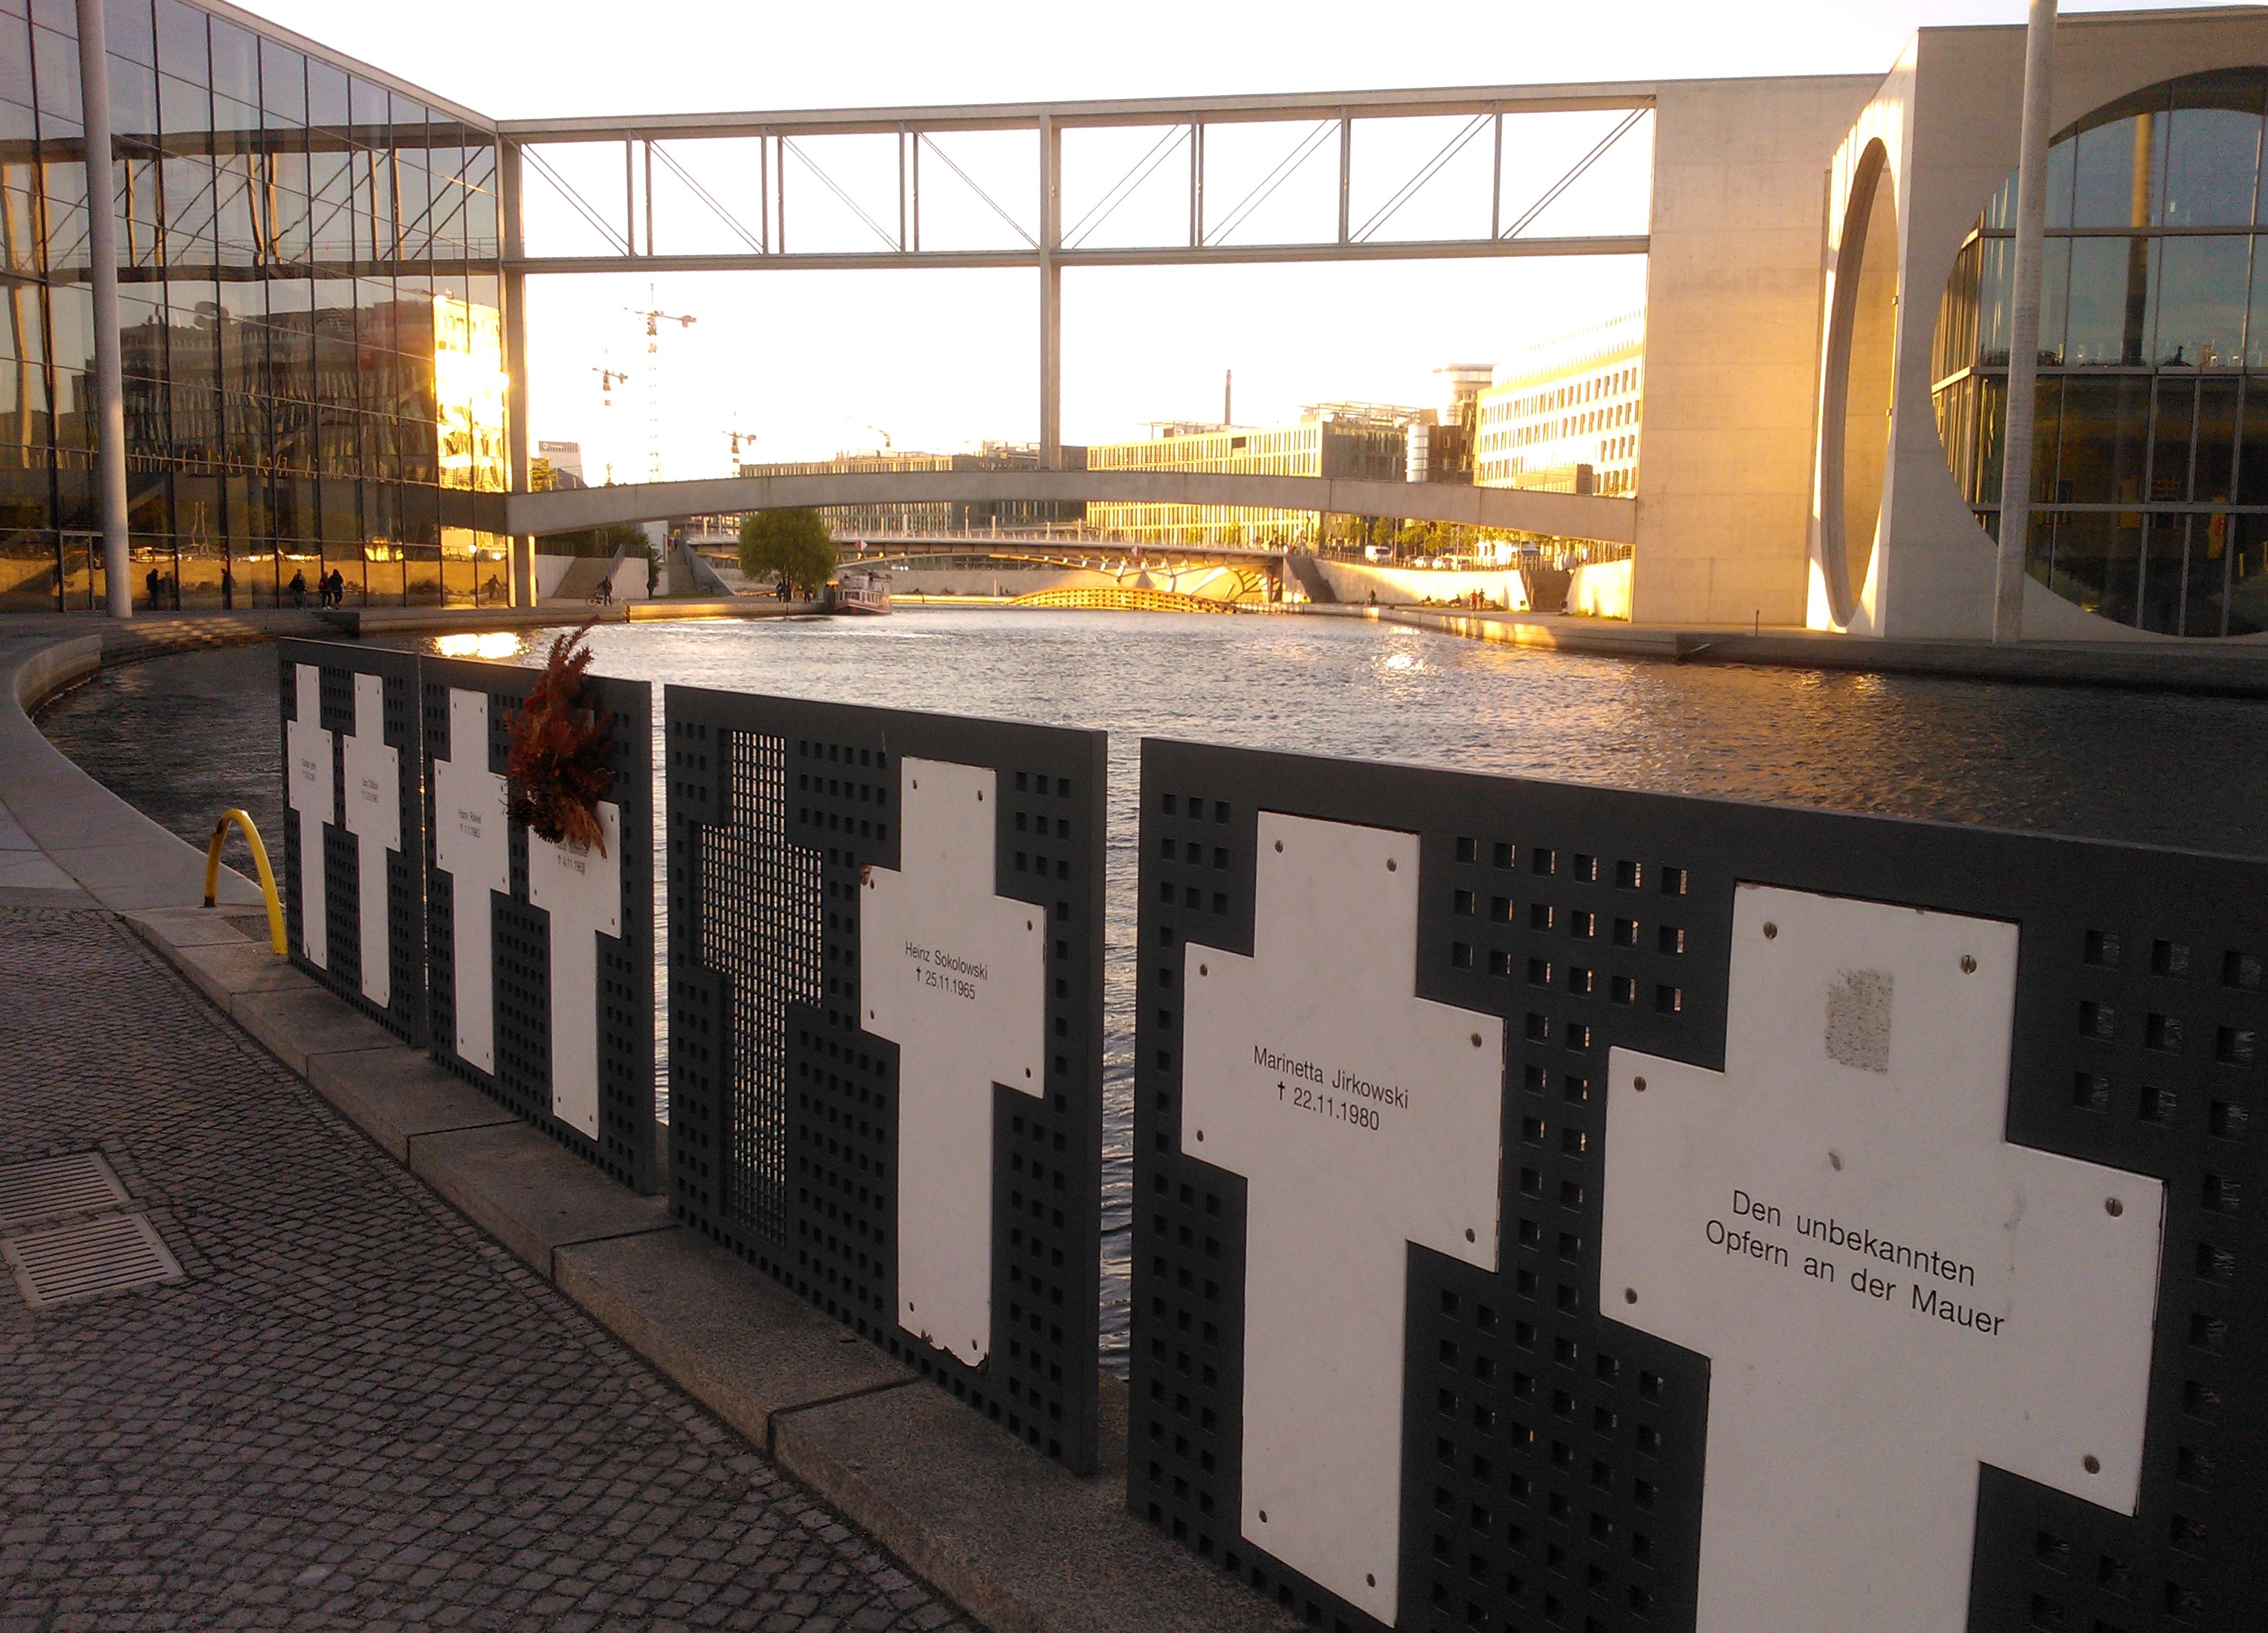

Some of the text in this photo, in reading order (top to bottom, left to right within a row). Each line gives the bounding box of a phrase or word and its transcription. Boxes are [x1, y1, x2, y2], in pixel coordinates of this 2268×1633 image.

[905, 941, 988, 980] Heinz Sokolowski
[925, 969, 976, 1000] 25.11.1965
[1254, 1045, 1409, 1110] Marinetta Jirkowski
[1293, 1087, 1379, 1131] 22.11.1980
[1733, 1189, 1974, 1287] Den unbekannten
[1705, 1219, 2006, 1336] Opfern an der Mauer
